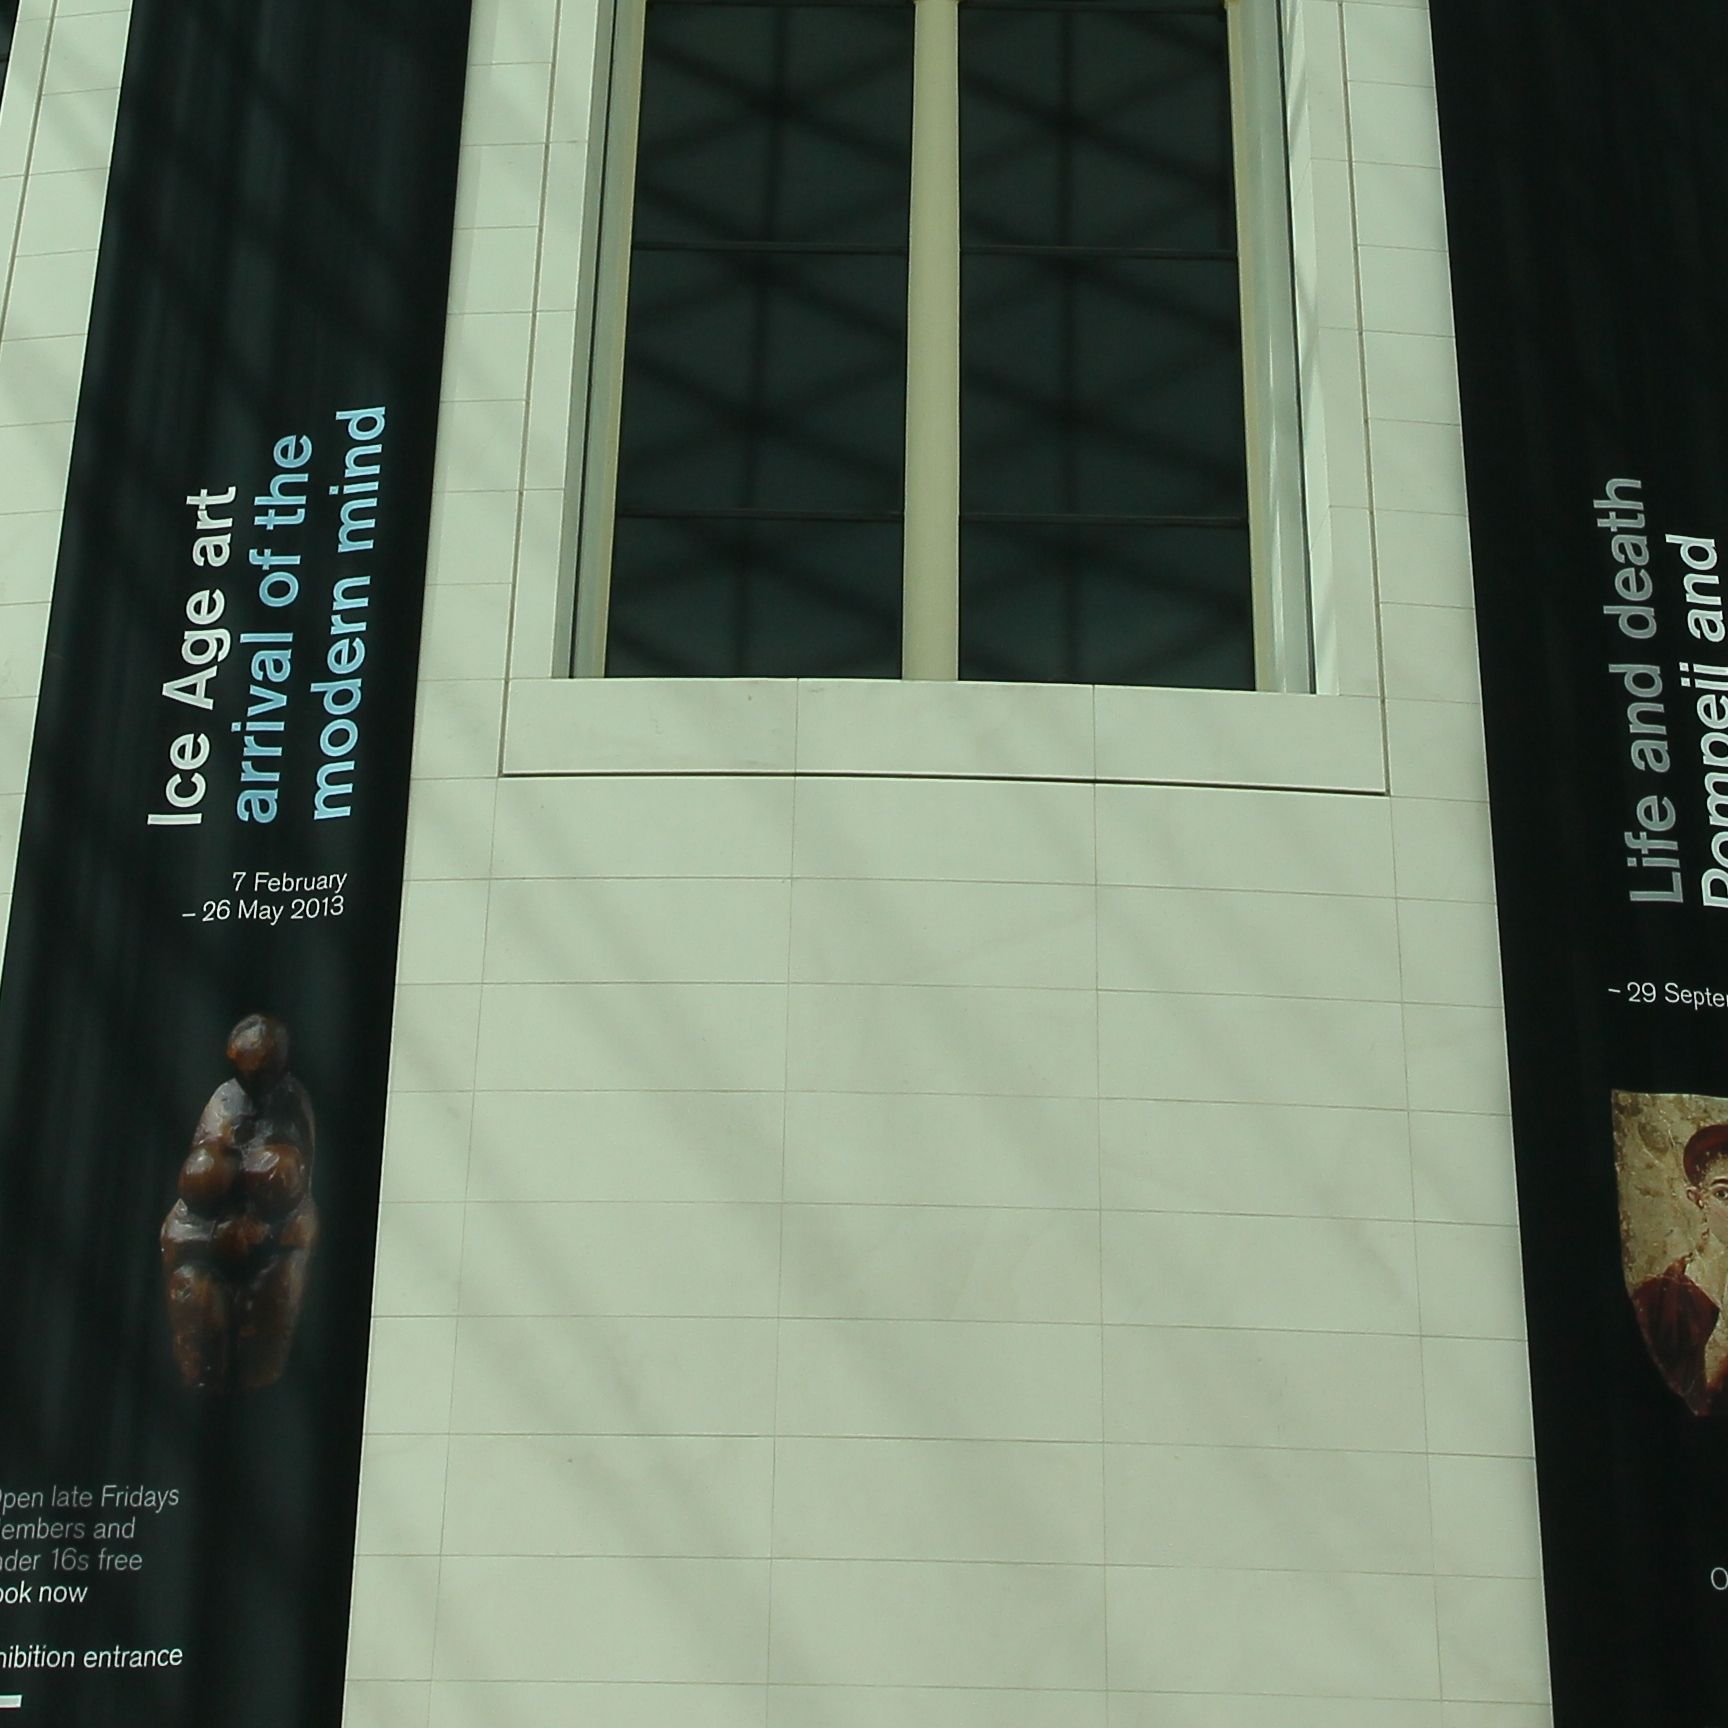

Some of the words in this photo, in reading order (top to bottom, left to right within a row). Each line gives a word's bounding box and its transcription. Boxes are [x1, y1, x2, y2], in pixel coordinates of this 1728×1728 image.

[253, 434, 313, 531] the
[328, 405, 386, 554] mind
[185, 485, 237, 568] art
[1592, 477, 1658, 640] death
[248, 548, 302, 608] of
[1664, 533, 1726, 643] and
[161, 588, 232, 711] Age
[228, 632, 294, 824] arrival
[309, 575, 371, 821] modern
[1607, 663, 1671, 774] and
[146, 732, 211, 826] Ice
[232, 871, 247, 892] 7
[254, 871, 348, 894] February
[1623, 794, 1684, 904] Life
[201, 898, 231, 922] 26
[237, 898, 285, 926] May
[290, 894, 345, 920] 2013
[1626, 981, 1657, 1003] 29
[51, 1484, 93, 1508] late
[100, 1484, 180, 1514] Fridays
[93, 1515, 136, 1540] and
[38, 1585, 89, 1603] now
[51, 1547, 89, 1571] 16s
[98, 1547, 143, 1571] free
[83, 1644, 184, 1669] entrance
